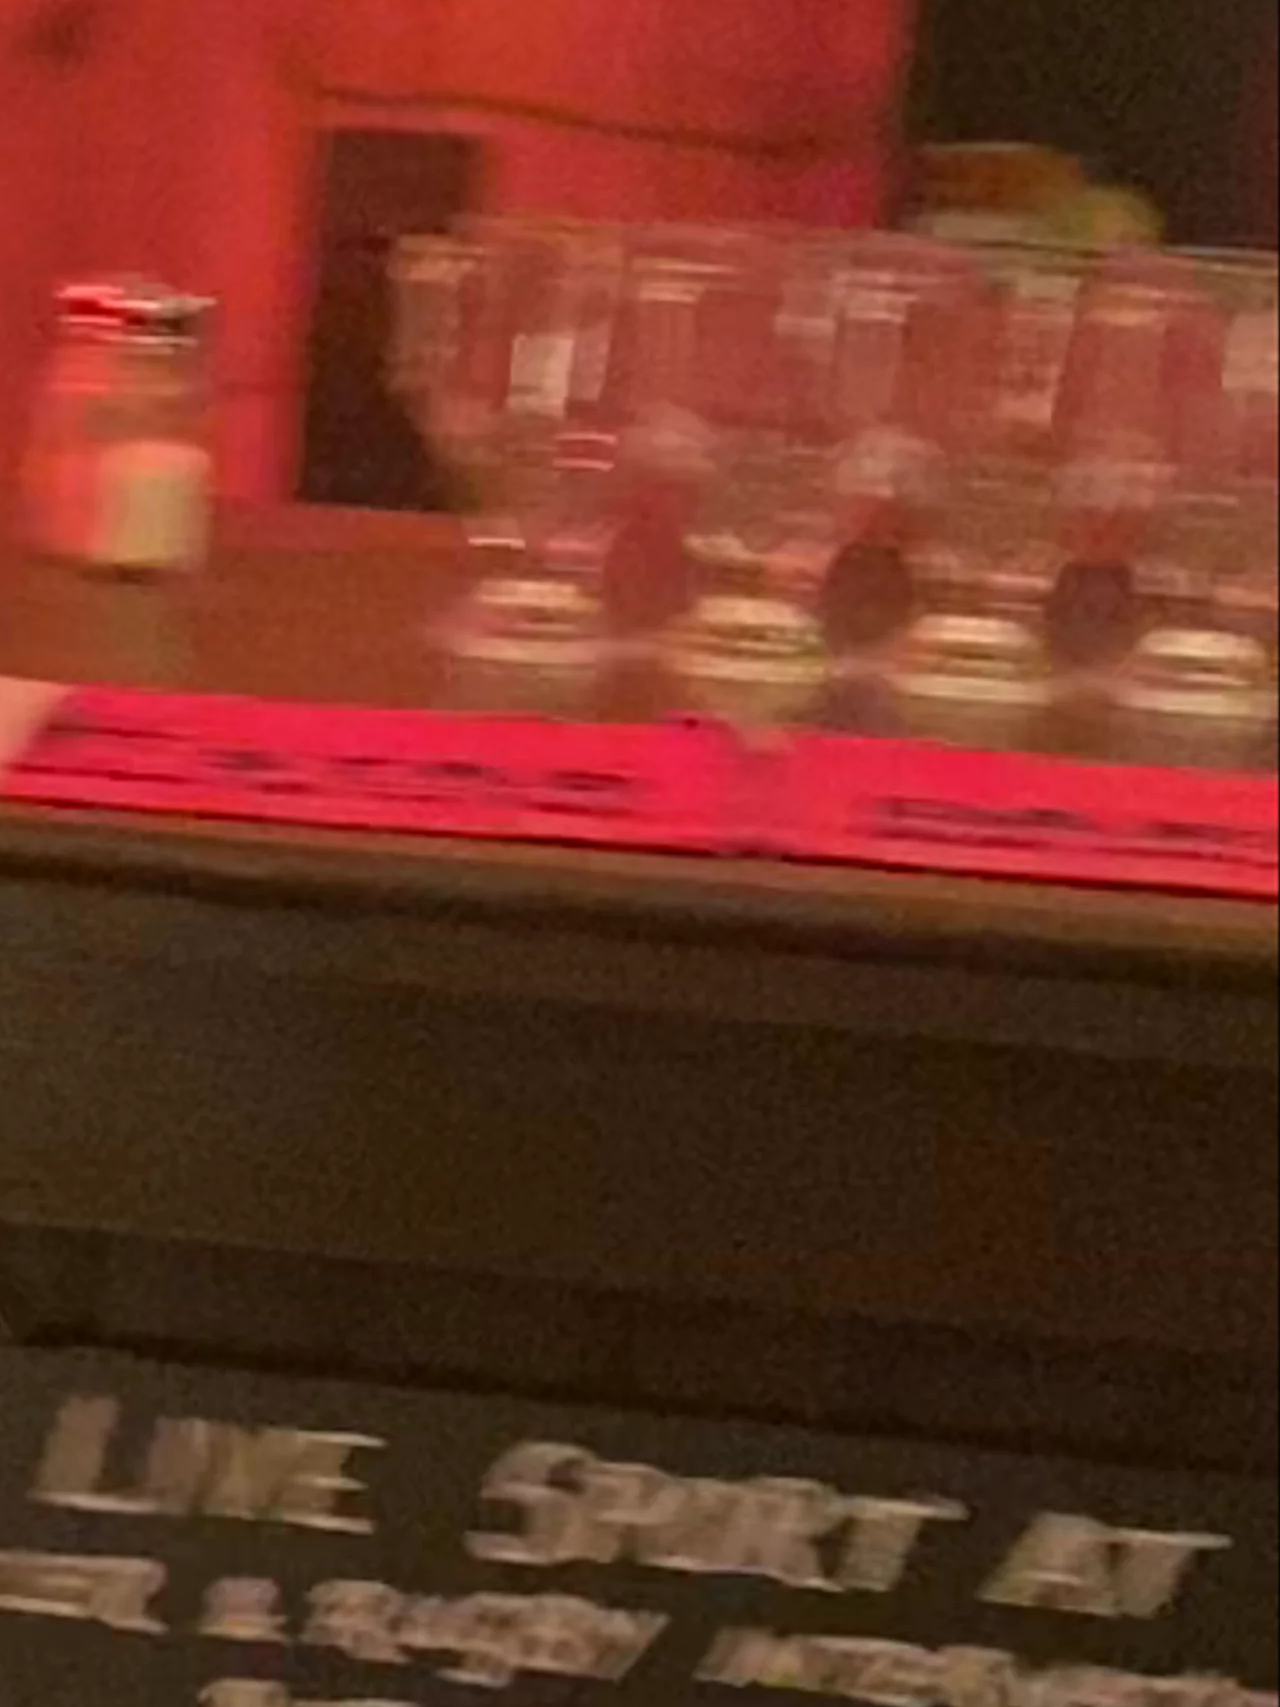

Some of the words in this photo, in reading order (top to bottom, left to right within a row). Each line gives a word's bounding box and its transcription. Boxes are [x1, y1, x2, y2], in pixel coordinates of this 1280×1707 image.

[32, 1393, 386, 1536] LIVE
[466, 1442, 967, 1592] SPORT
[978, 1513, 1232, 1617] AT
